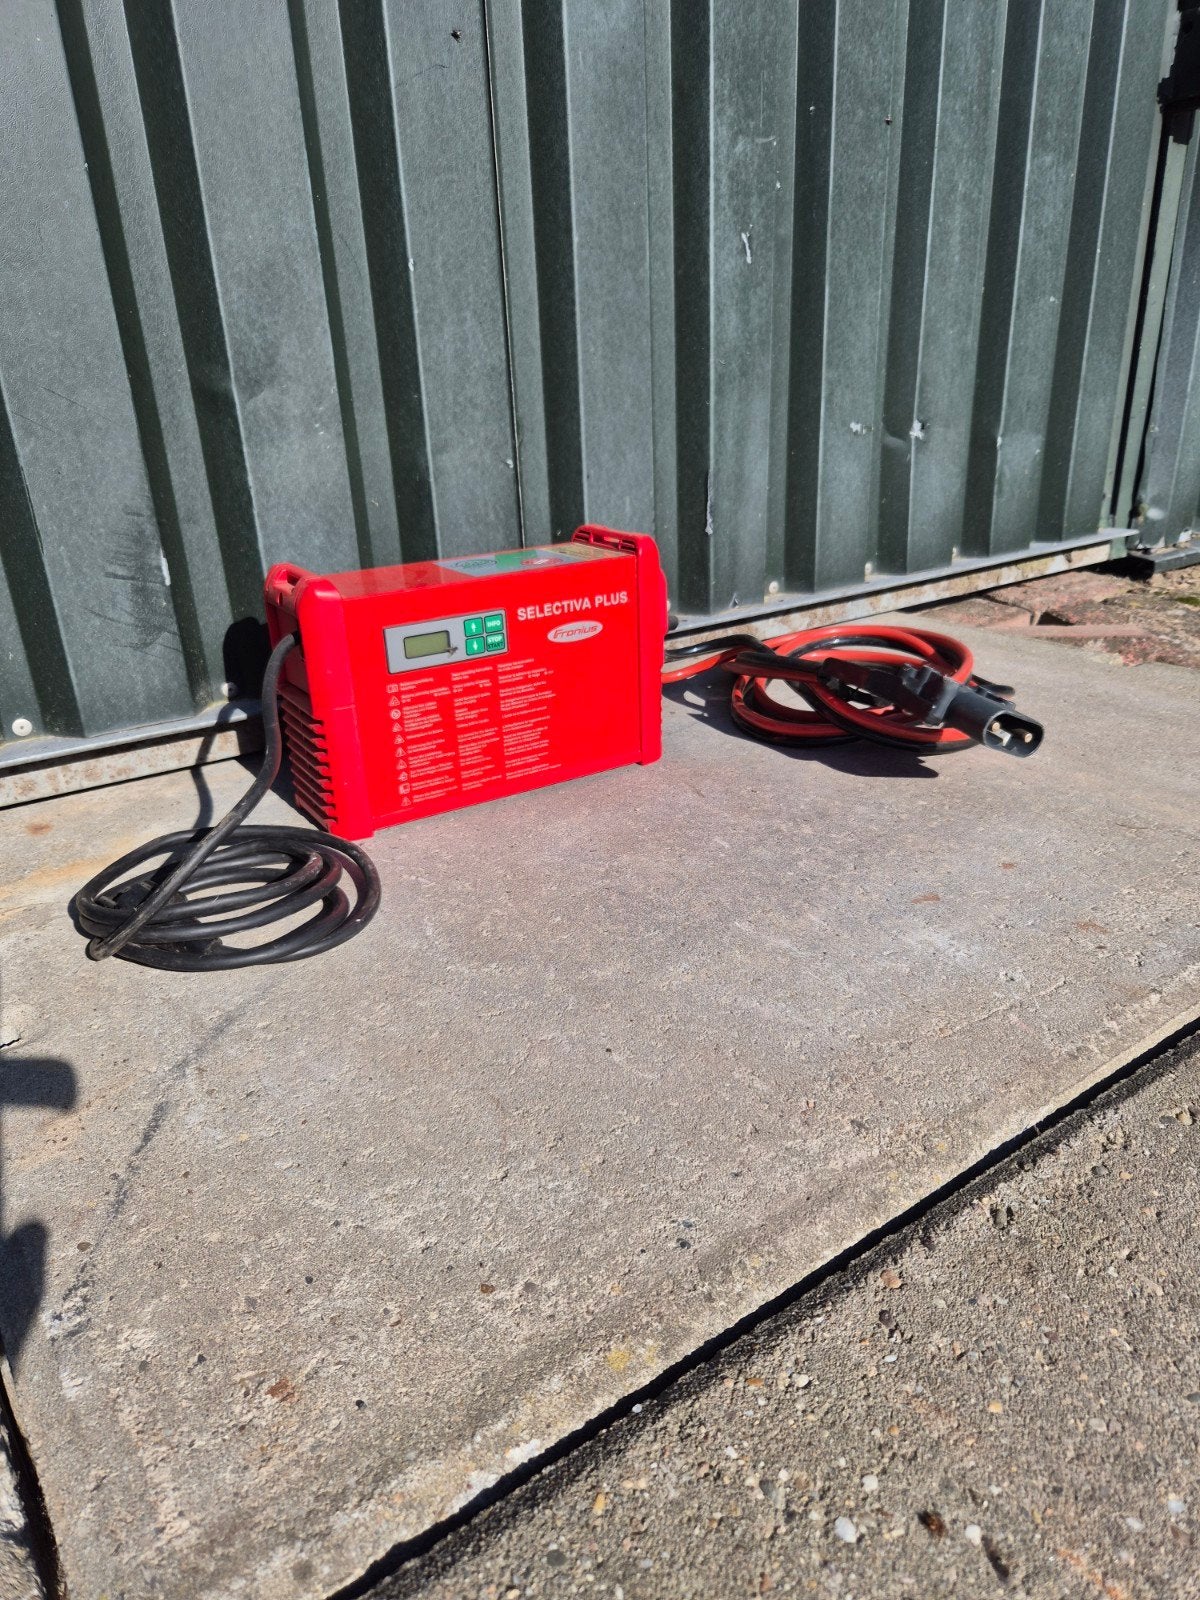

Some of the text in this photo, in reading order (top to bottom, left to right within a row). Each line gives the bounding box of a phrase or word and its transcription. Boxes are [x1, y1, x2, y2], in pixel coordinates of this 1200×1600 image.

[517, 591, 628, 621] SELECTIVA PLUS
[487, 620, 501, 628] INFO
[553, 625, 598, 639] Fronius
[487, 635, 502, 643] STOP
